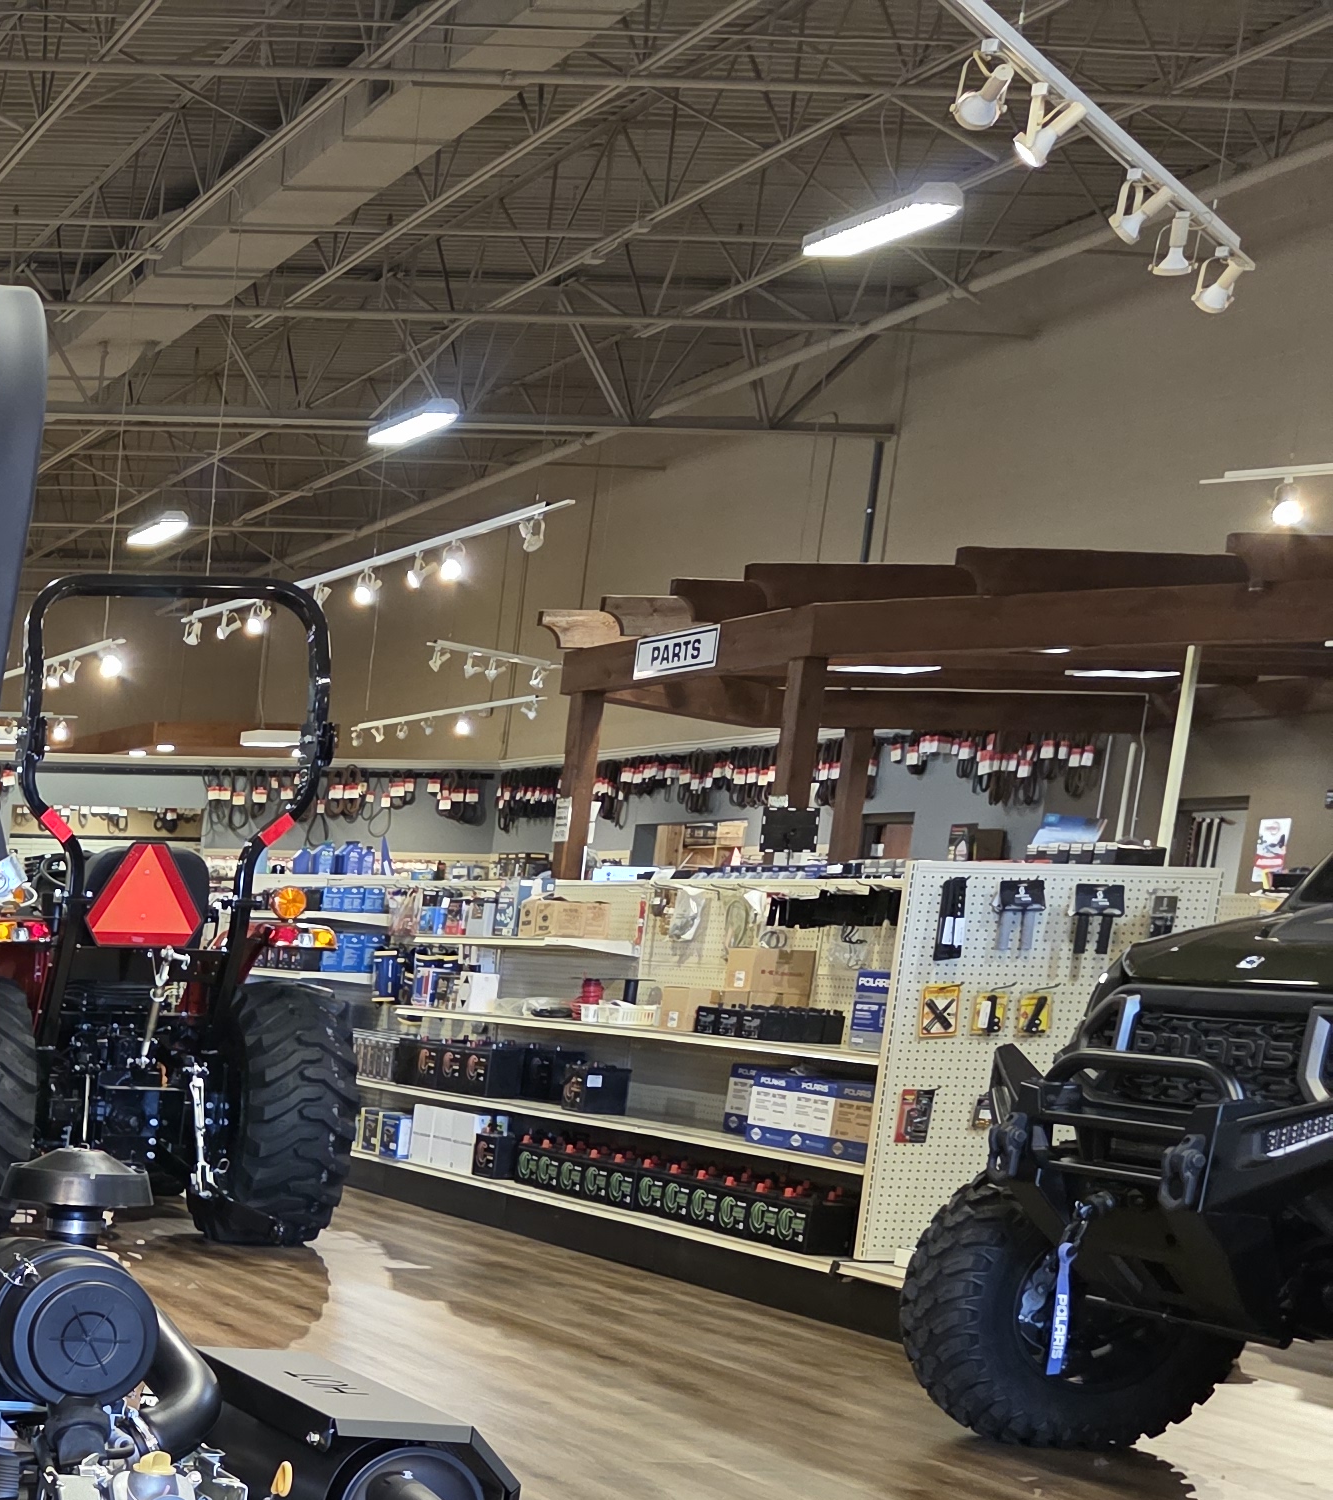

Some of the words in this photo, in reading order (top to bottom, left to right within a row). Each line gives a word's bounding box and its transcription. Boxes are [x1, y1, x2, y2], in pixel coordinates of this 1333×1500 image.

[650, 638, 702, 667] PARTS
[760, 1076, 786, 1087] POLARIS
[801, 1082, 829, 1093] POLARIS
[843, 1087, 872, 1098] POLARIS
[1051, 1294, 1069, 1360] POLARIS
